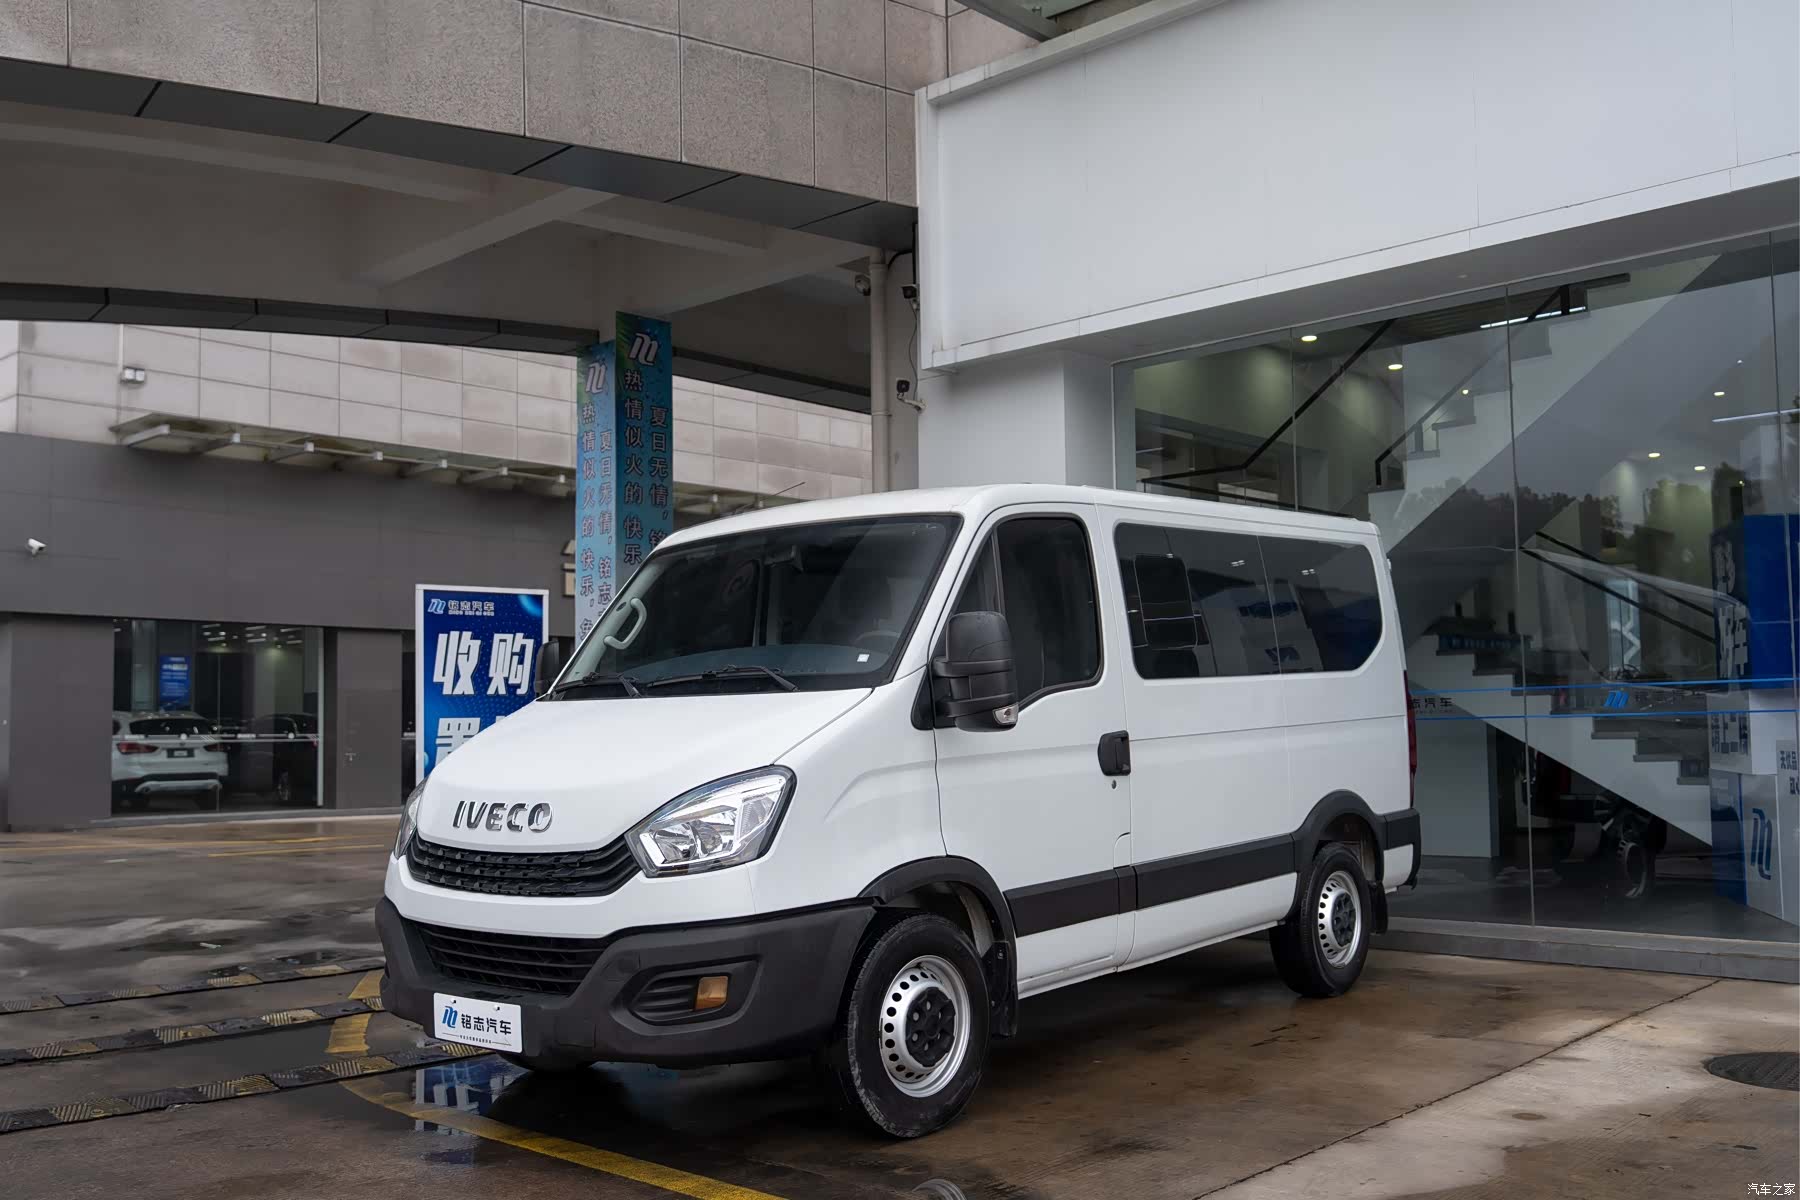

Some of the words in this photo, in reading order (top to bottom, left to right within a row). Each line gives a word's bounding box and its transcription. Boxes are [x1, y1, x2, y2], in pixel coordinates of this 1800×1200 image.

[624, 369, 643, 565] 热情似火的快乐
[598, 430, 613, 617] 夏日无情，铭志
[433, 630, 535, 695] 收购
[452, 800, 553, 833] IVECO
[461, 1013, 512, 1036] 铭志汽车
